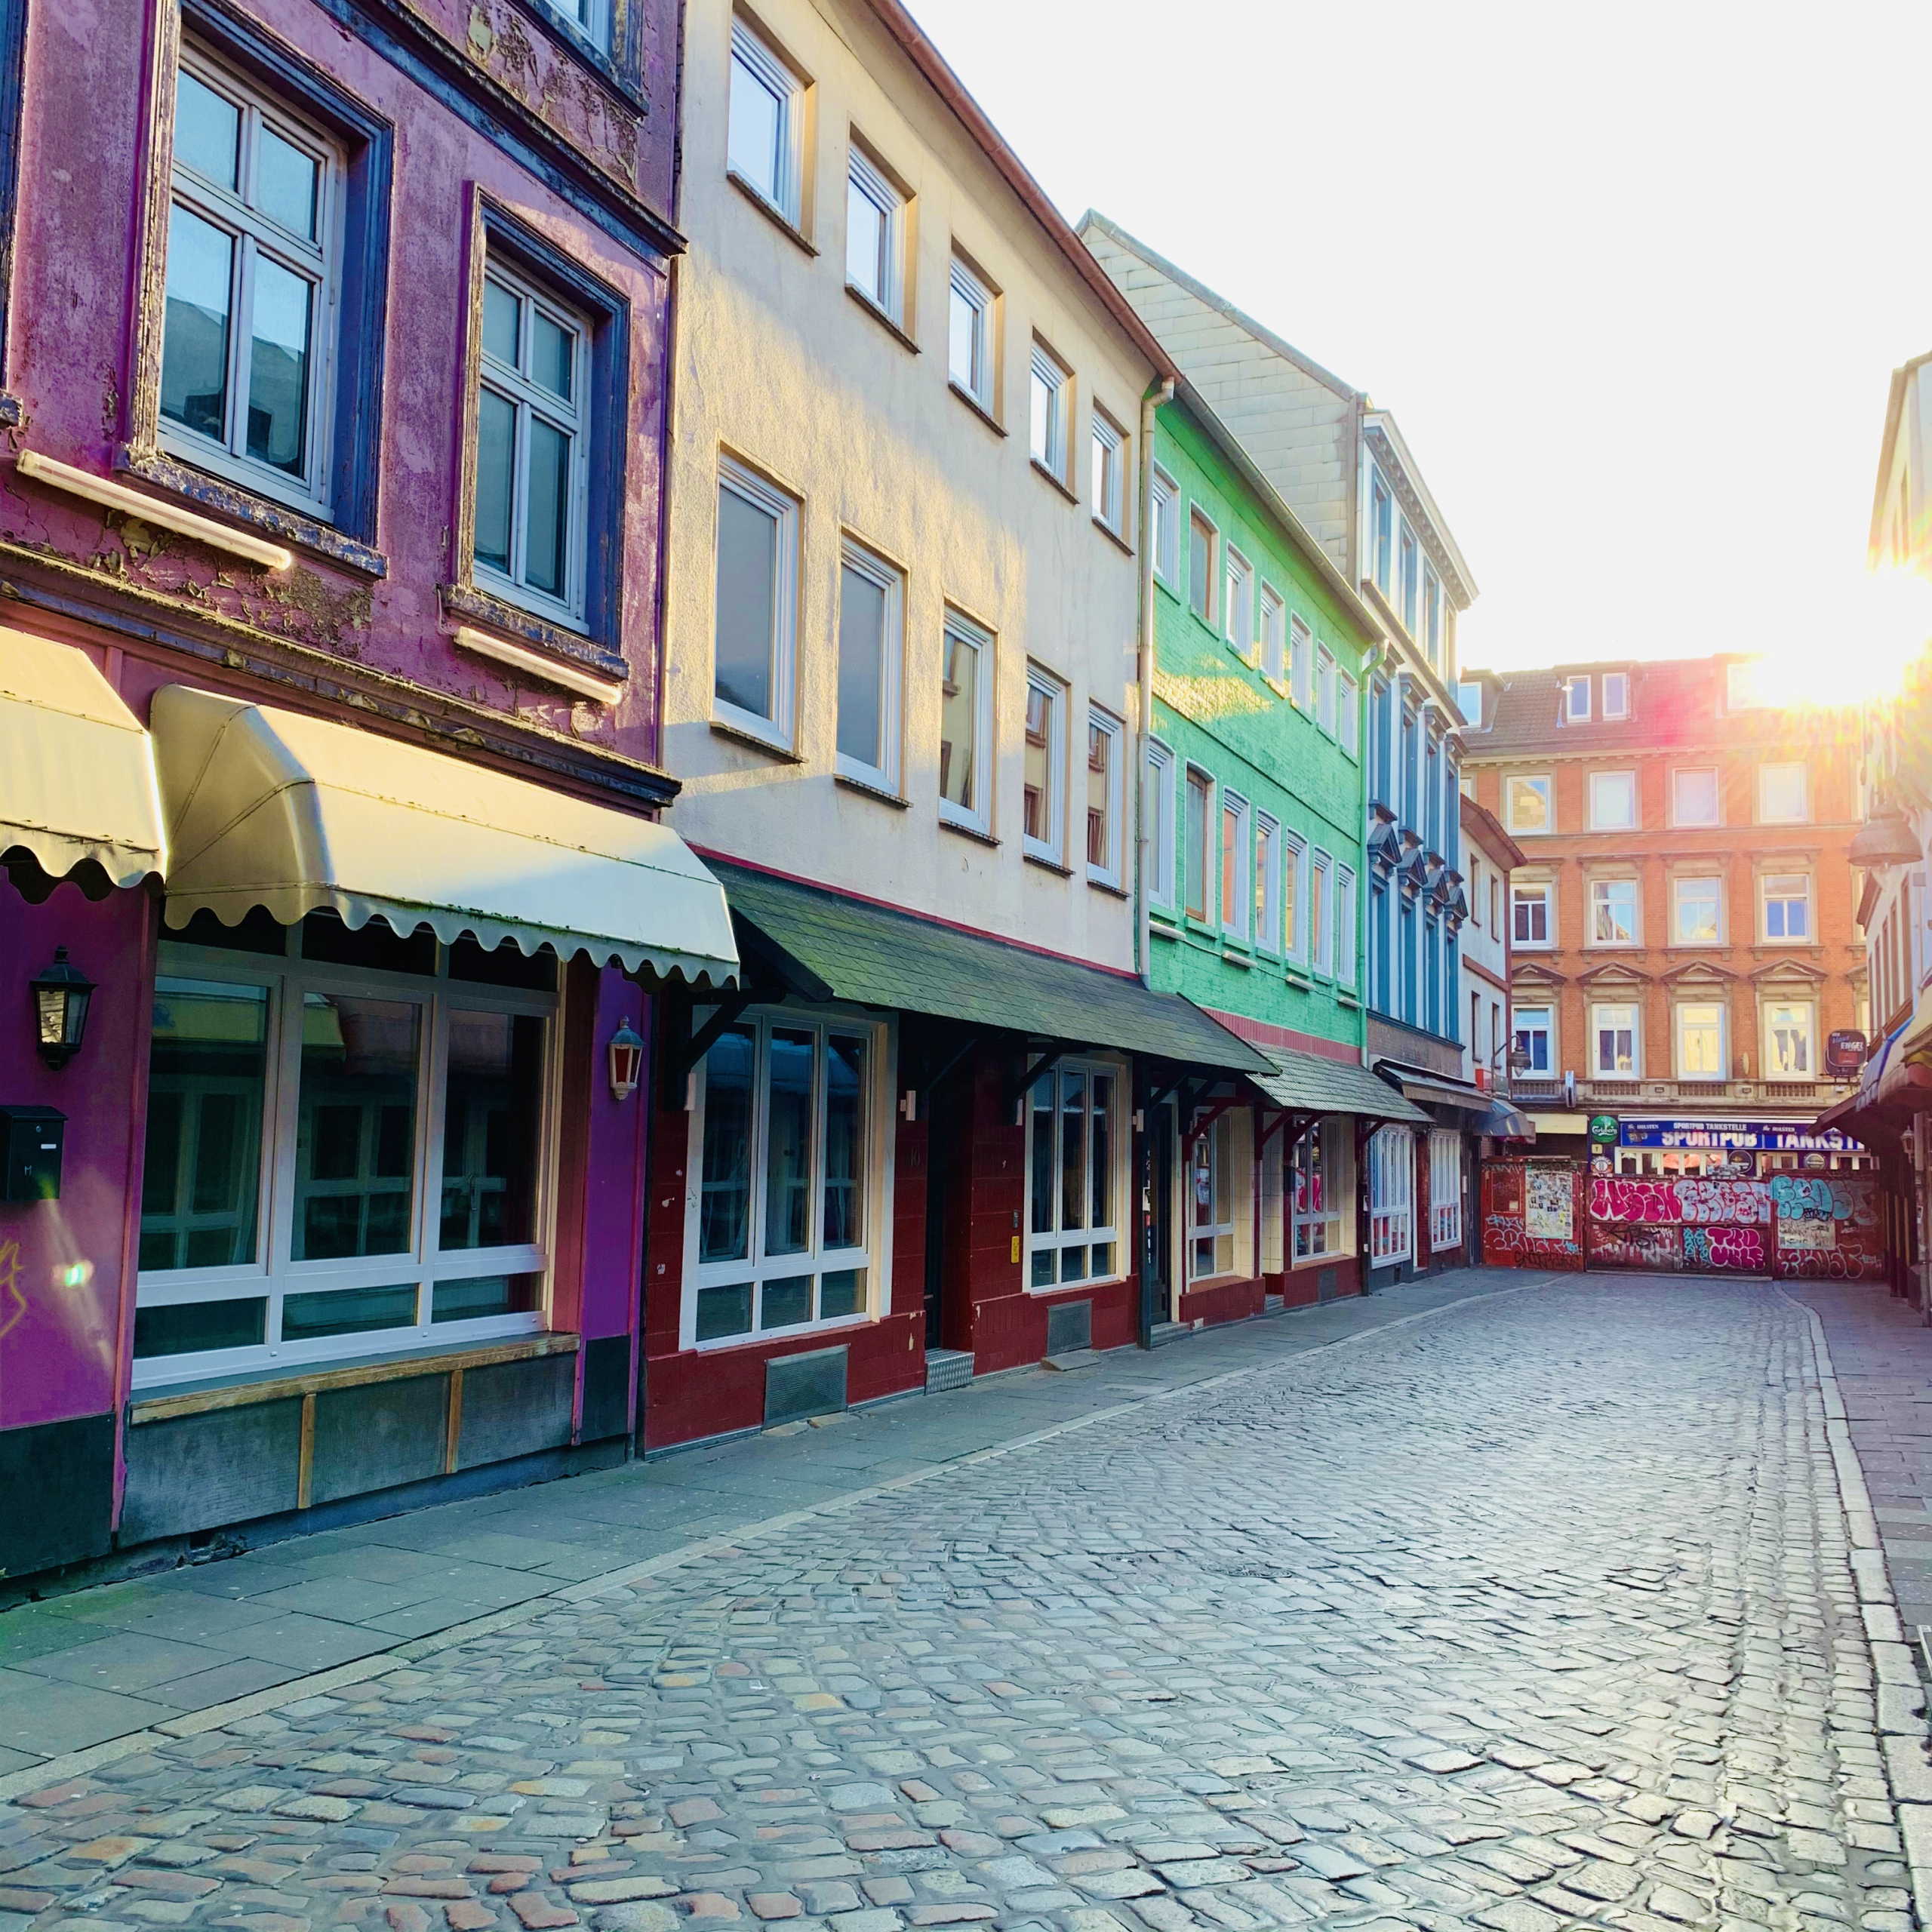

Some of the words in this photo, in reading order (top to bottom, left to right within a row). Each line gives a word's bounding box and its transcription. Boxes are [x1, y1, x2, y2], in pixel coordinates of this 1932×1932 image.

[1841, 1041, 1863, 1050] ENGEL
[1592, 1124, 1617, 1136] Carlsberg
[1673, 1122, 1705, 1131] SPORTPUB
[1706, 1123, 1747, 1131] TANKSTELLE
[1662, 1131, 1758, 1147] SPORTPUB
